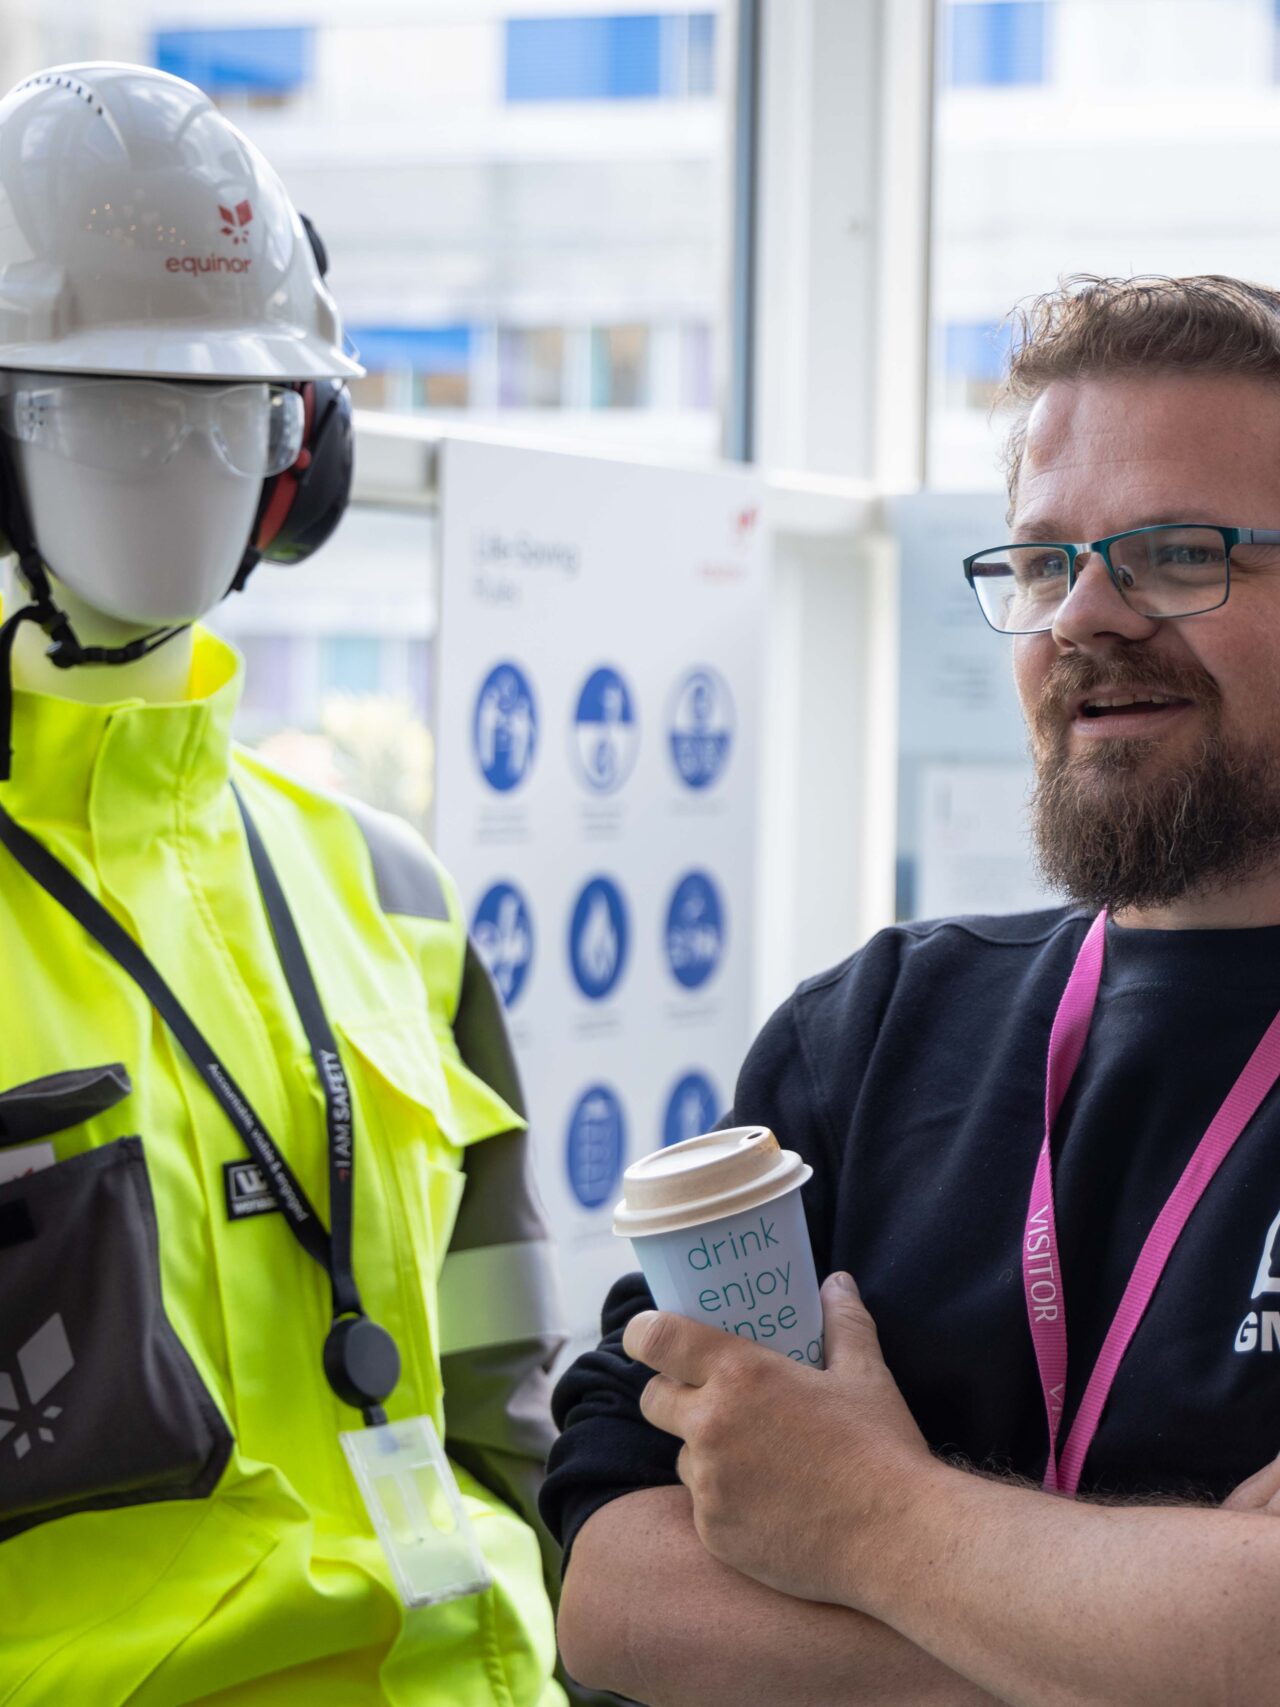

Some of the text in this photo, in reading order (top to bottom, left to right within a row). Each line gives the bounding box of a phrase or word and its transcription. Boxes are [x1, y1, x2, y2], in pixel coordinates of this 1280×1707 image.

[165, 253, 252, 277] equinor
[319, 1049, 351, 1122] SAFETY
[334, 1124, 352, 1159] AM
[687, 1217, 780, 1271] drink
[1027, 1205, 1058, 1323] VISITOR
[698, 1261, 791, 1313] enjoy
